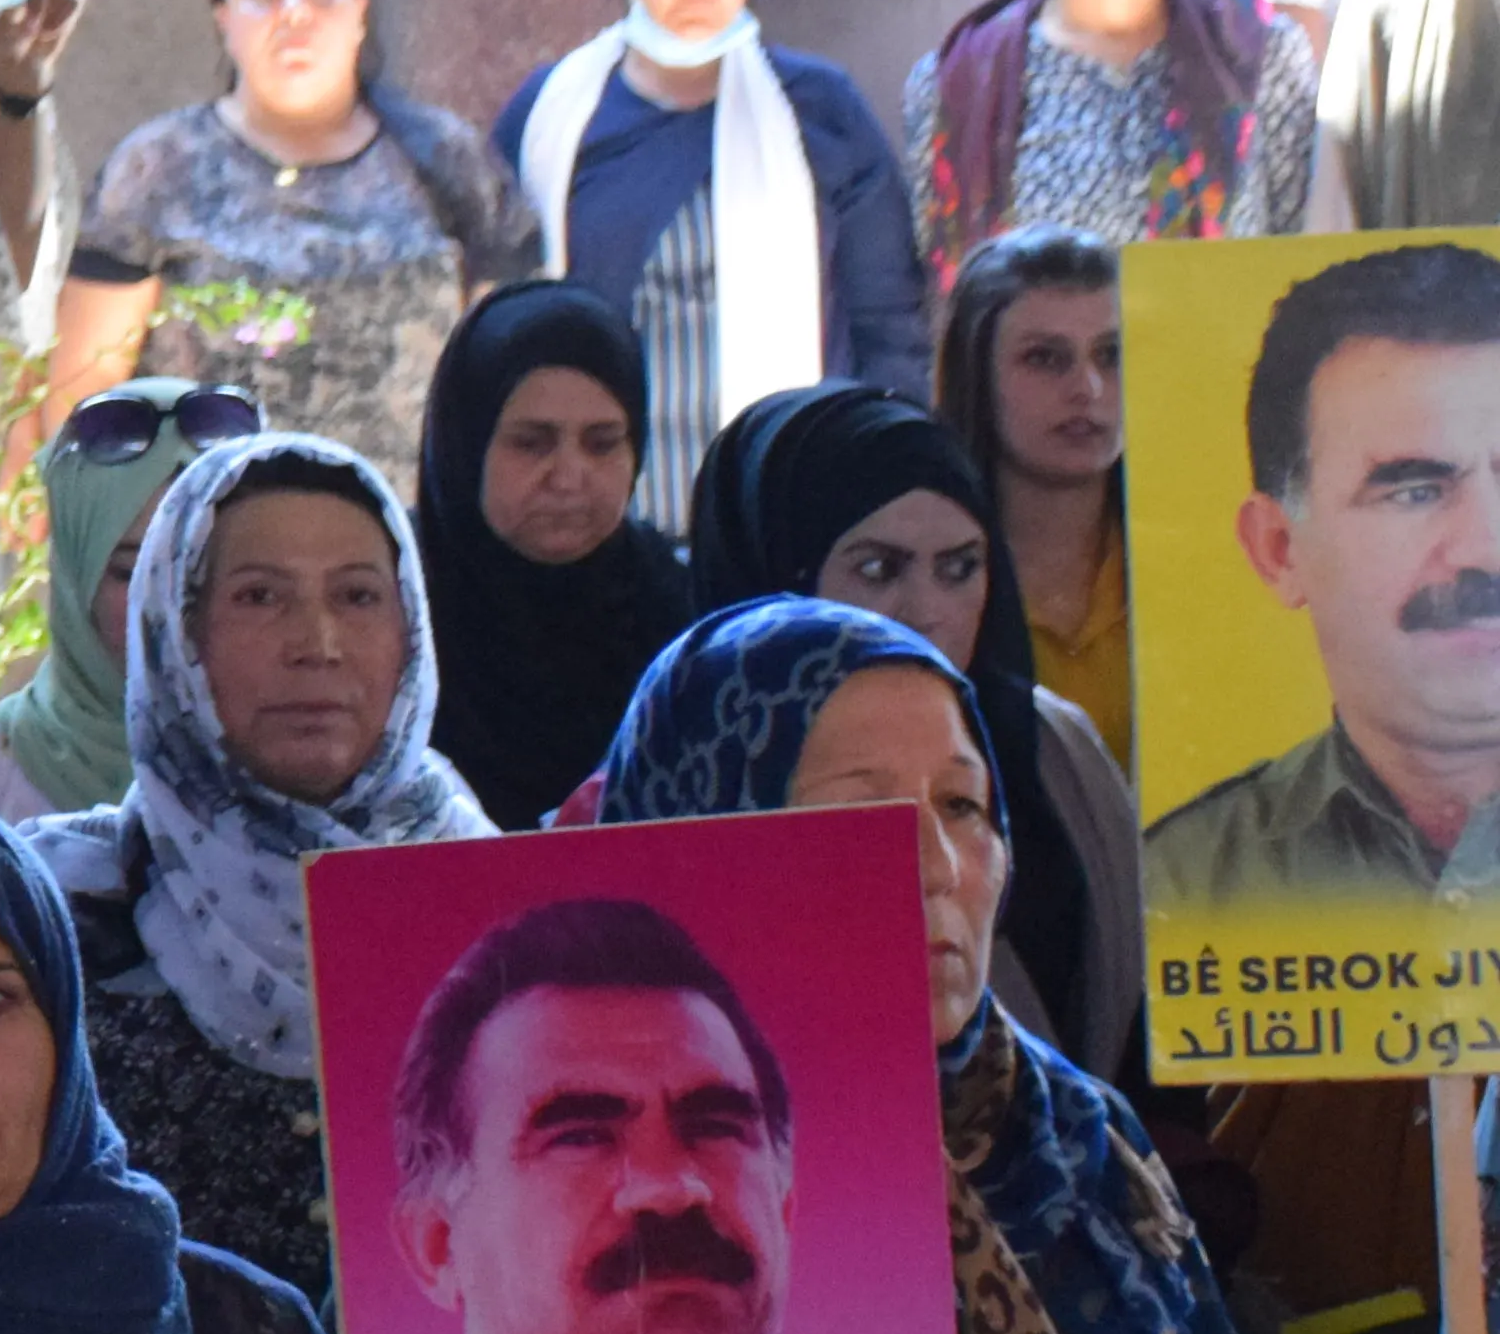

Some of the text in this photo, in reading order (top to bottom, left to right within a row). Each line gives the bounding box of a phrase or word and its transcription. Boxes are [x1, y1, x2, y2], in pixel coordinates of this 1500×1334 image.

[1161, 943, 1221, 996] BÊ
[1238, 951, 1419, 993] SEROK
[1171, 1006, 1343, 1060] القائد
